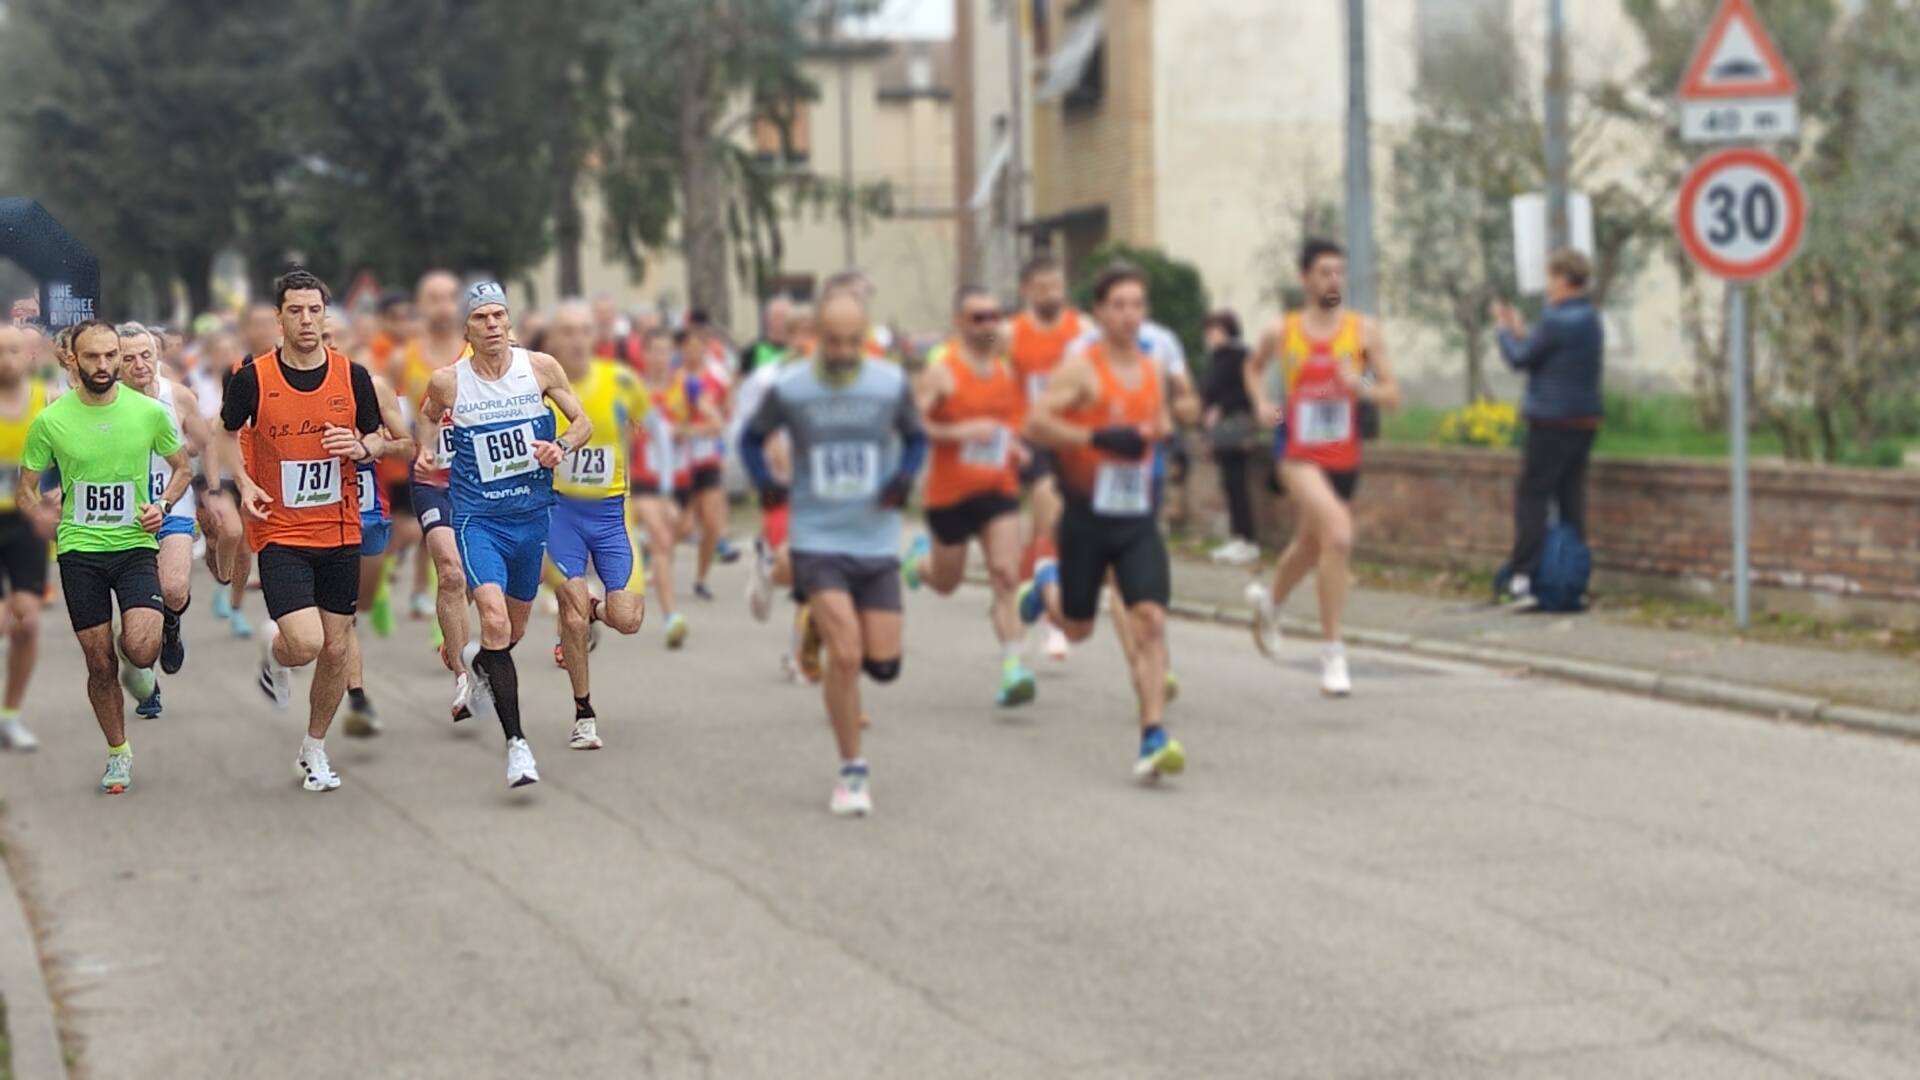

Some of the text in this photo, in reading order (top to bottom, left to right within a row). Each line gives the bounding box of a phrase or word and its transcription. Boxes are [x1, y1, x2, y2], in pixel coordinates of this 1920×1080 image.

[1707, 181, 1776, 247] 30
[457, 393, 540, 414] QUADRILATERO
[486, 428, 528, 463] 698
[572, 447, 605, 474] 723
[296, 460, 332, 491] 737
[86, 484, 125, 511] 658
[482, 485, 531, 499] VENTURA
